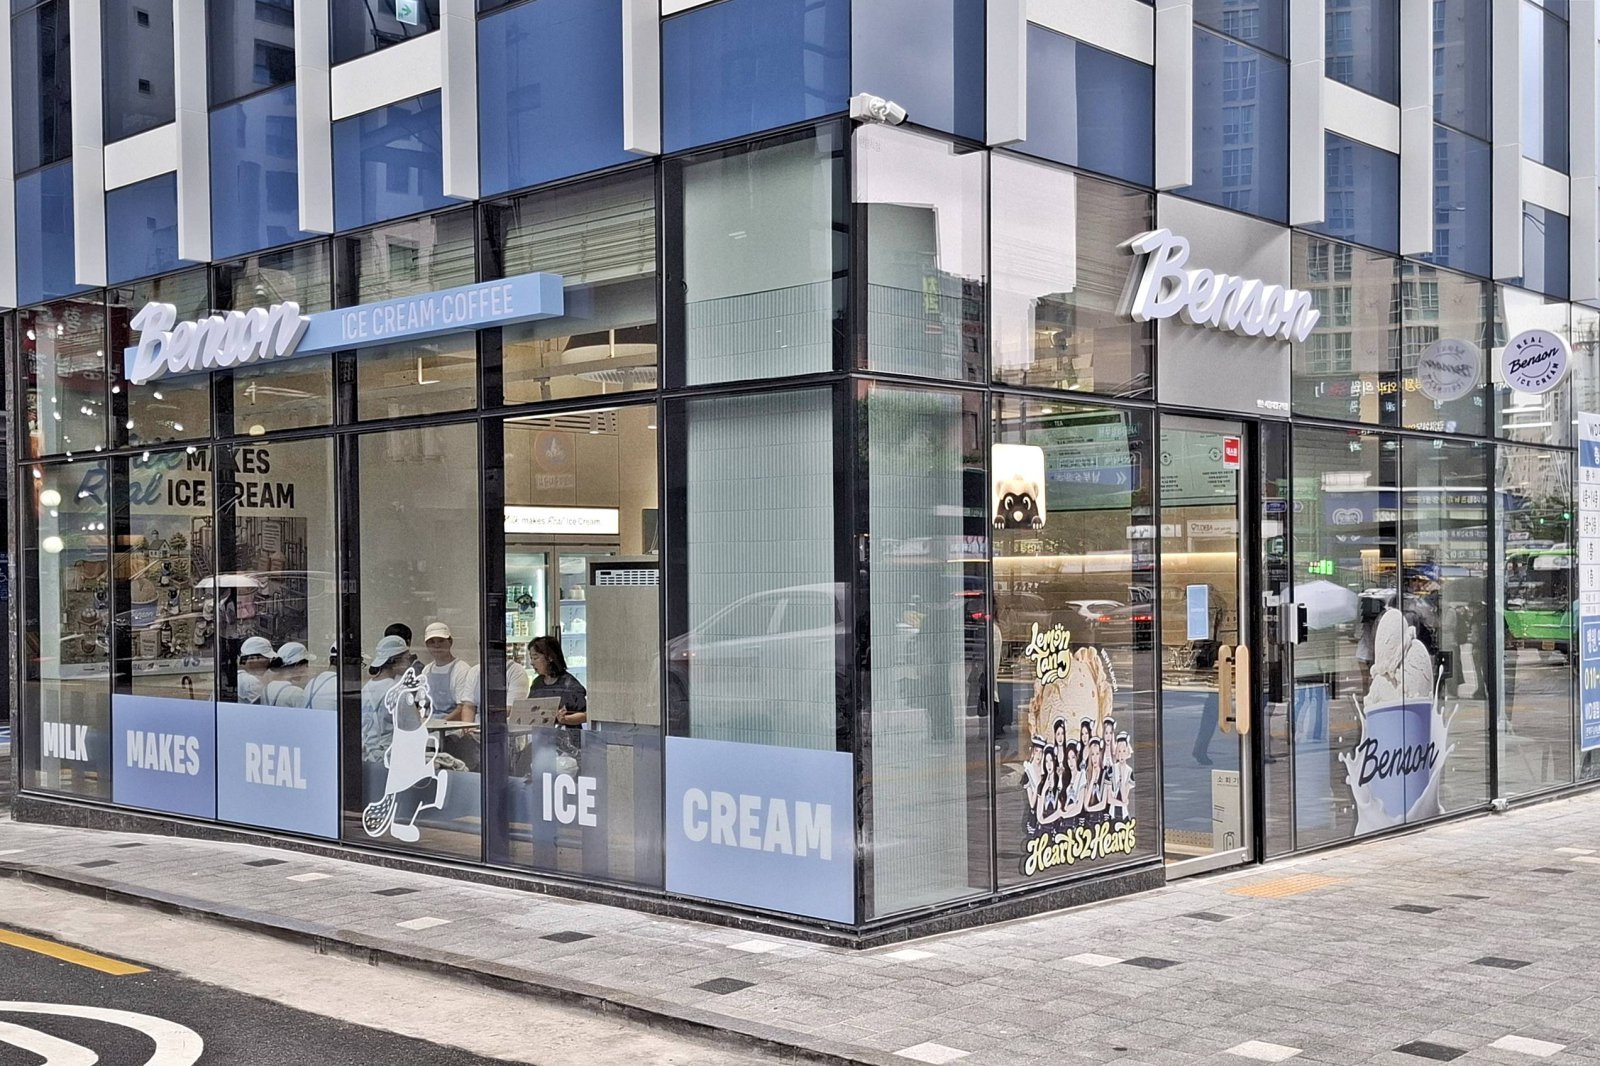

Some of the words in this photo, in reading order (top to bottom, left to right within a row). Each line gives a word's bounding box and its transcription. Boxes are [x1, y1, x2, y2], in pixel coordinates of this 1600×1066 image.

[1131, 228, 1320, 342] Benson
[130, 301, 311, 386] Benson
[341, 310, 368, 341] ICE
[1516, 336, 1543, 350] REAL
[1508, 347, 1560, 375] Benson
[1516, 376, 1531, 387] ICE
[1535, 362, 1560, 386] CREAM
[167, 479, 206, 507] ICE
[1025, 621, 1071, 657] Lemon
[1031, 649, 1072, 685] Tang
[1357, 737, 1440, 788] Benson
[43, 721, 89, 762] MILK
[126, 730, 201, 777] MAKES
[245, 742, 307, 790] REAL
[542, 772, 598, 827] ICE
[682, 787, 833, 861] CREAM
